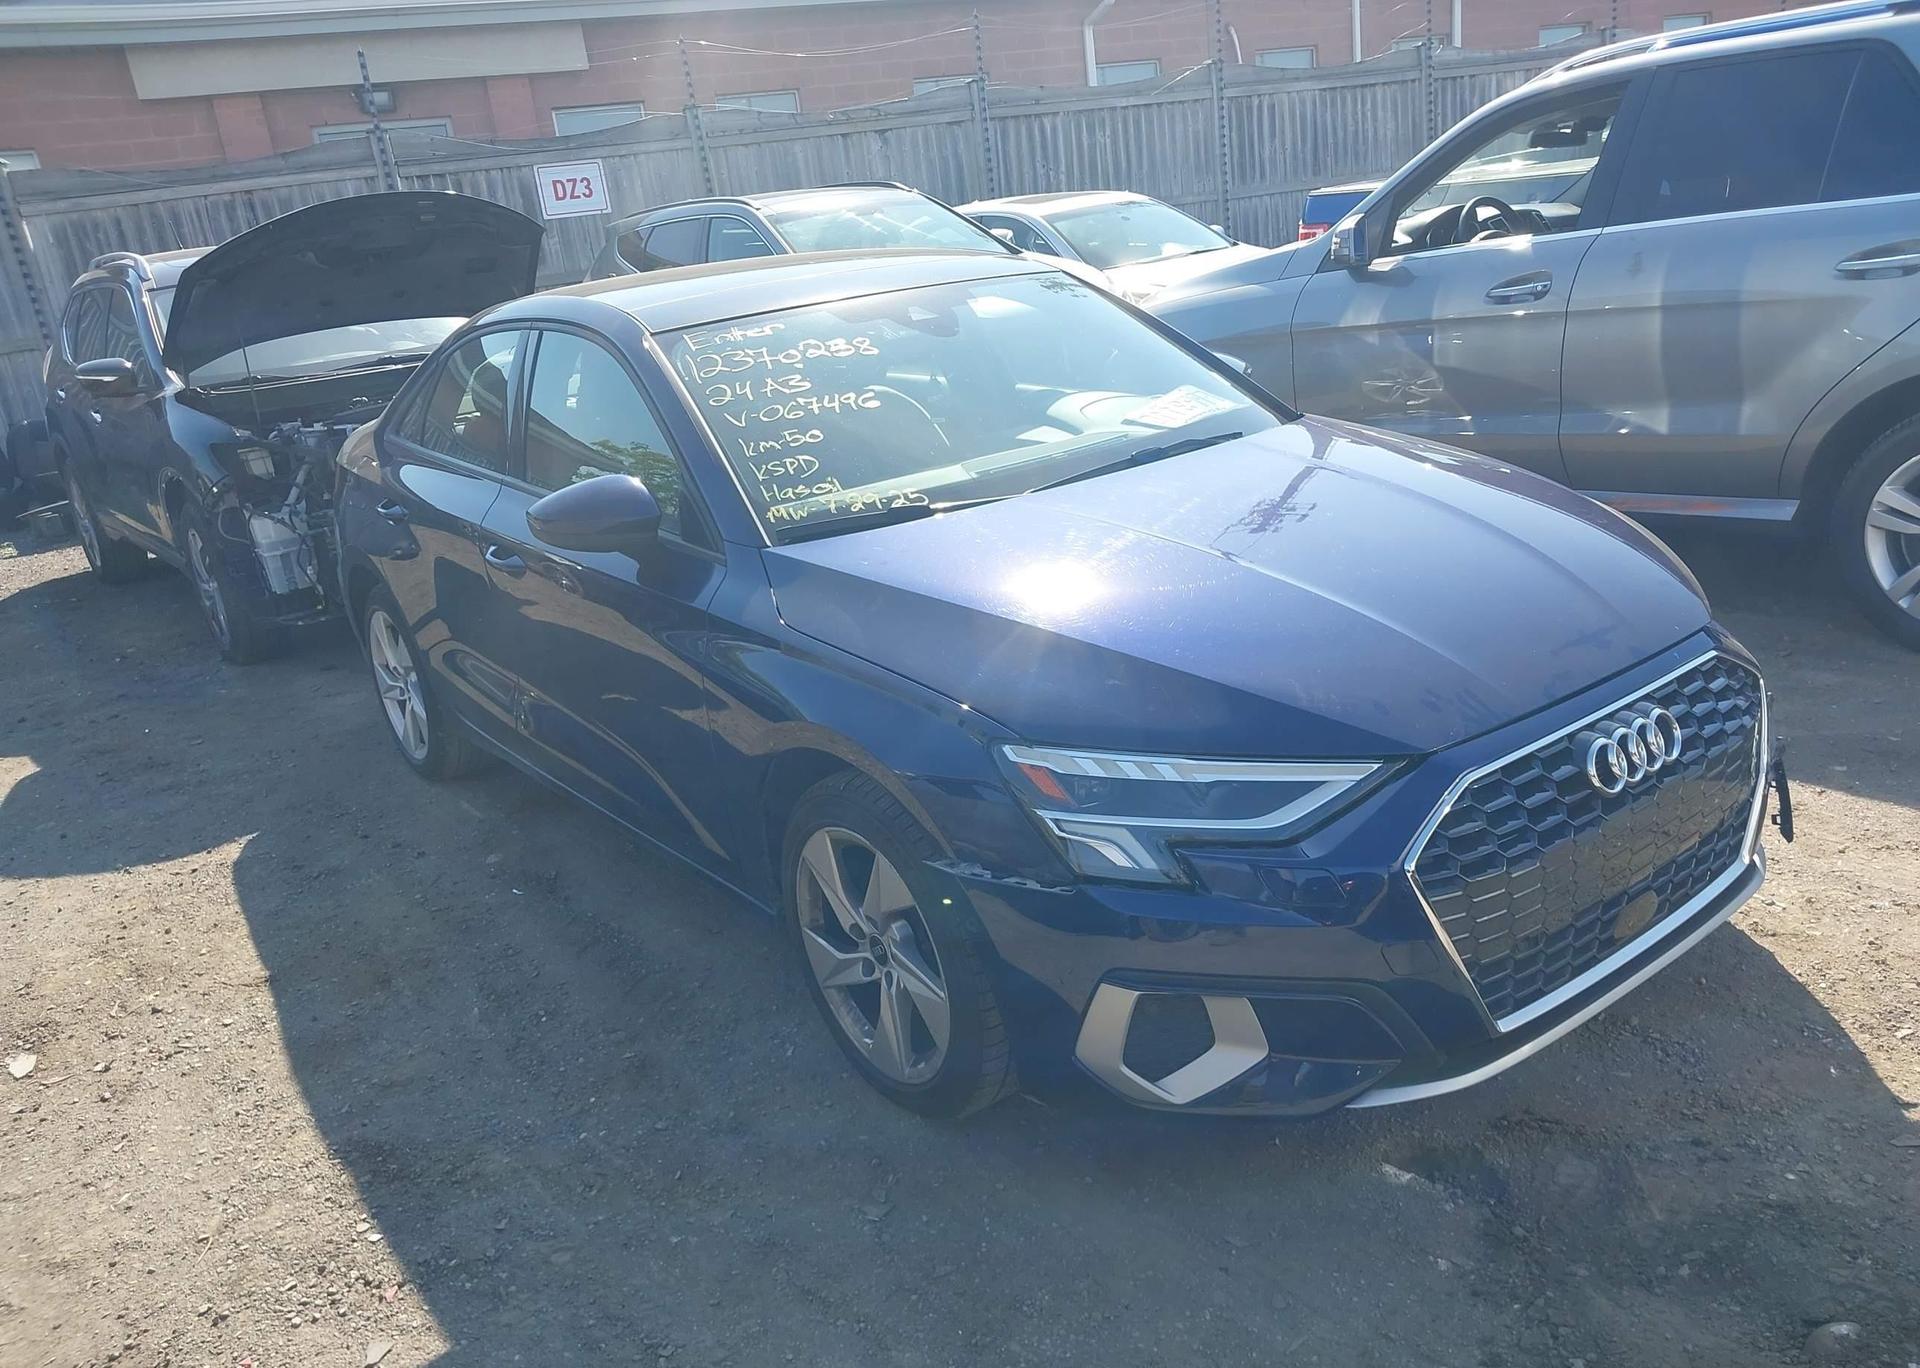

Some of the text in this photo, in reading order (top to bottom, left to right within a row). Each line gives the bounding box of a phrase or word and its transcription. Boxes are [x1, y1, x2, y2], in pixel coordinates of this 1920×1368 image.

[551, 176, 594, 202] DZ3
[706, 374, 812, 406] 24 A3
